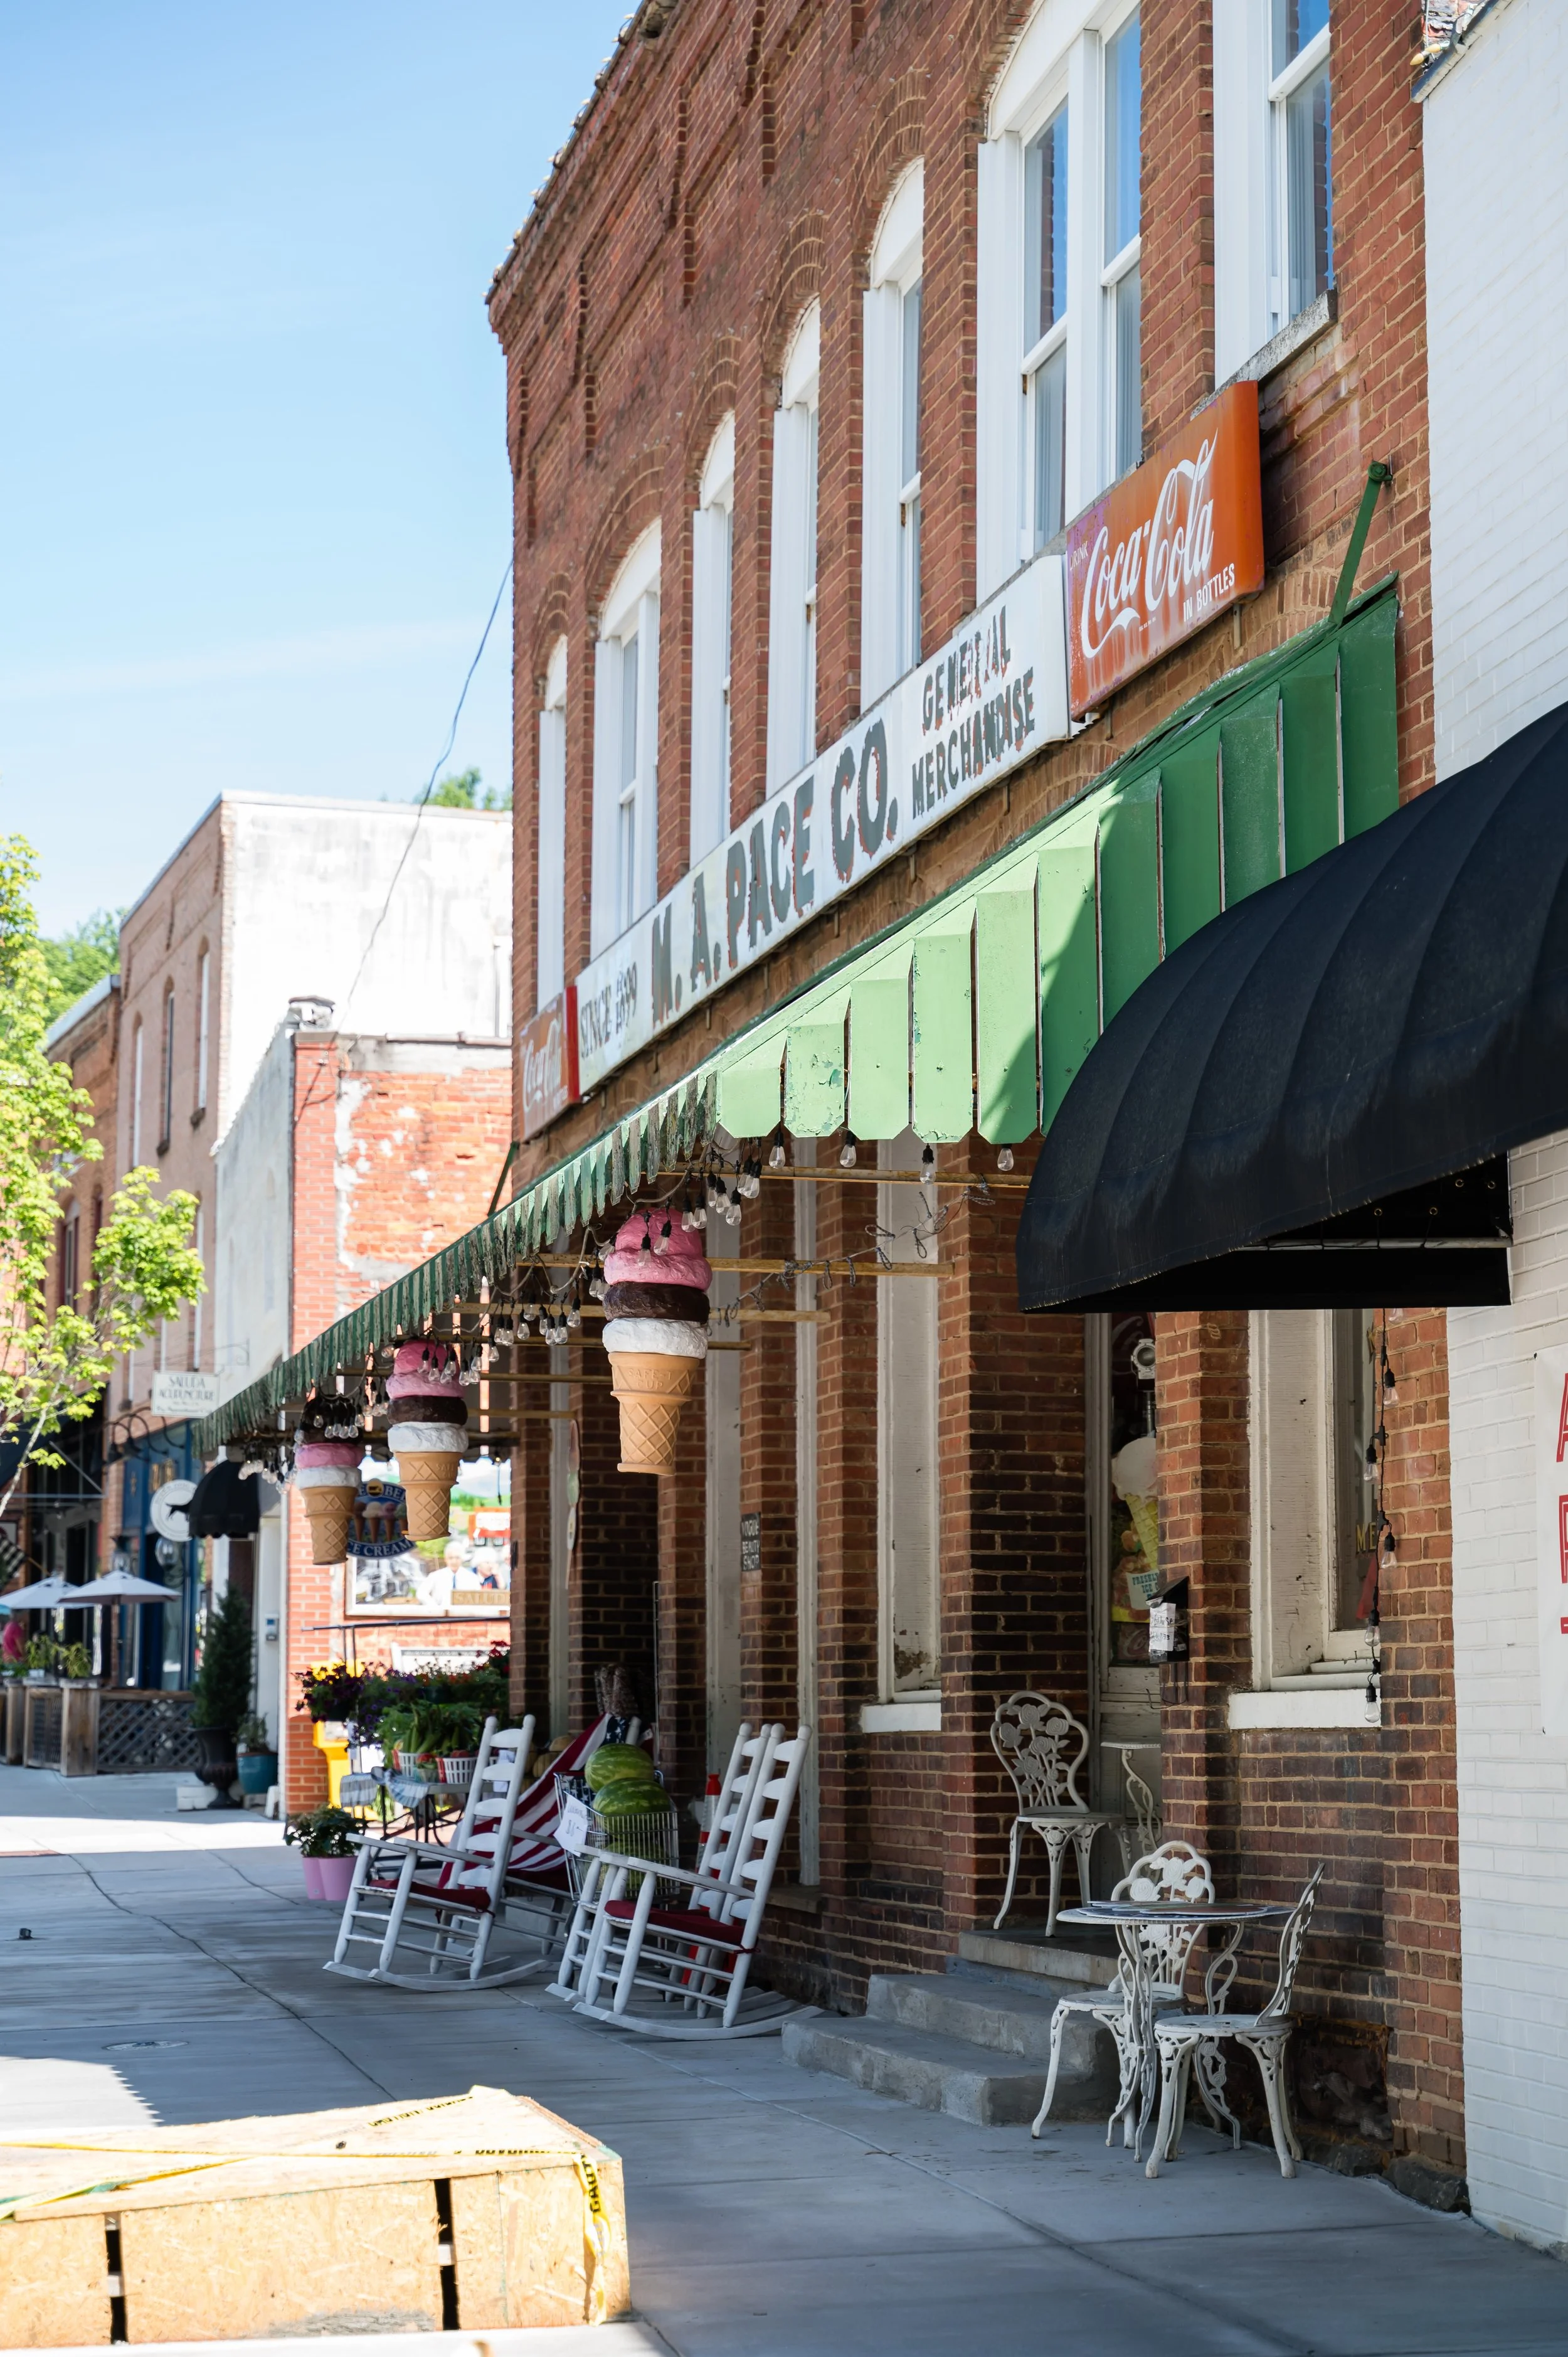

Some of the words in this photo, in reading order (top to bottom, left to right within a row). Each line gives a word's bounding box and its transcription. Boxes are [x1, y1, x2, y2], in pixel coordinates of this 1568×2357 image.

[1069, 540, 1088, 571] DRINK
[1082, 428, 1218, 659] Coca-Cola
[1183, 600, 1193, 622] IN
[1197, 563, 1235, 614] BOTTLES
[922, 605, 1010, 735] GENERAL
[912, 668, 1035, 818] MERCHANDISE
[726, 776, 815, 969] PACE
[831, 717, 898, 883] CO.
[581, 984, 611, 1059] SINCE
